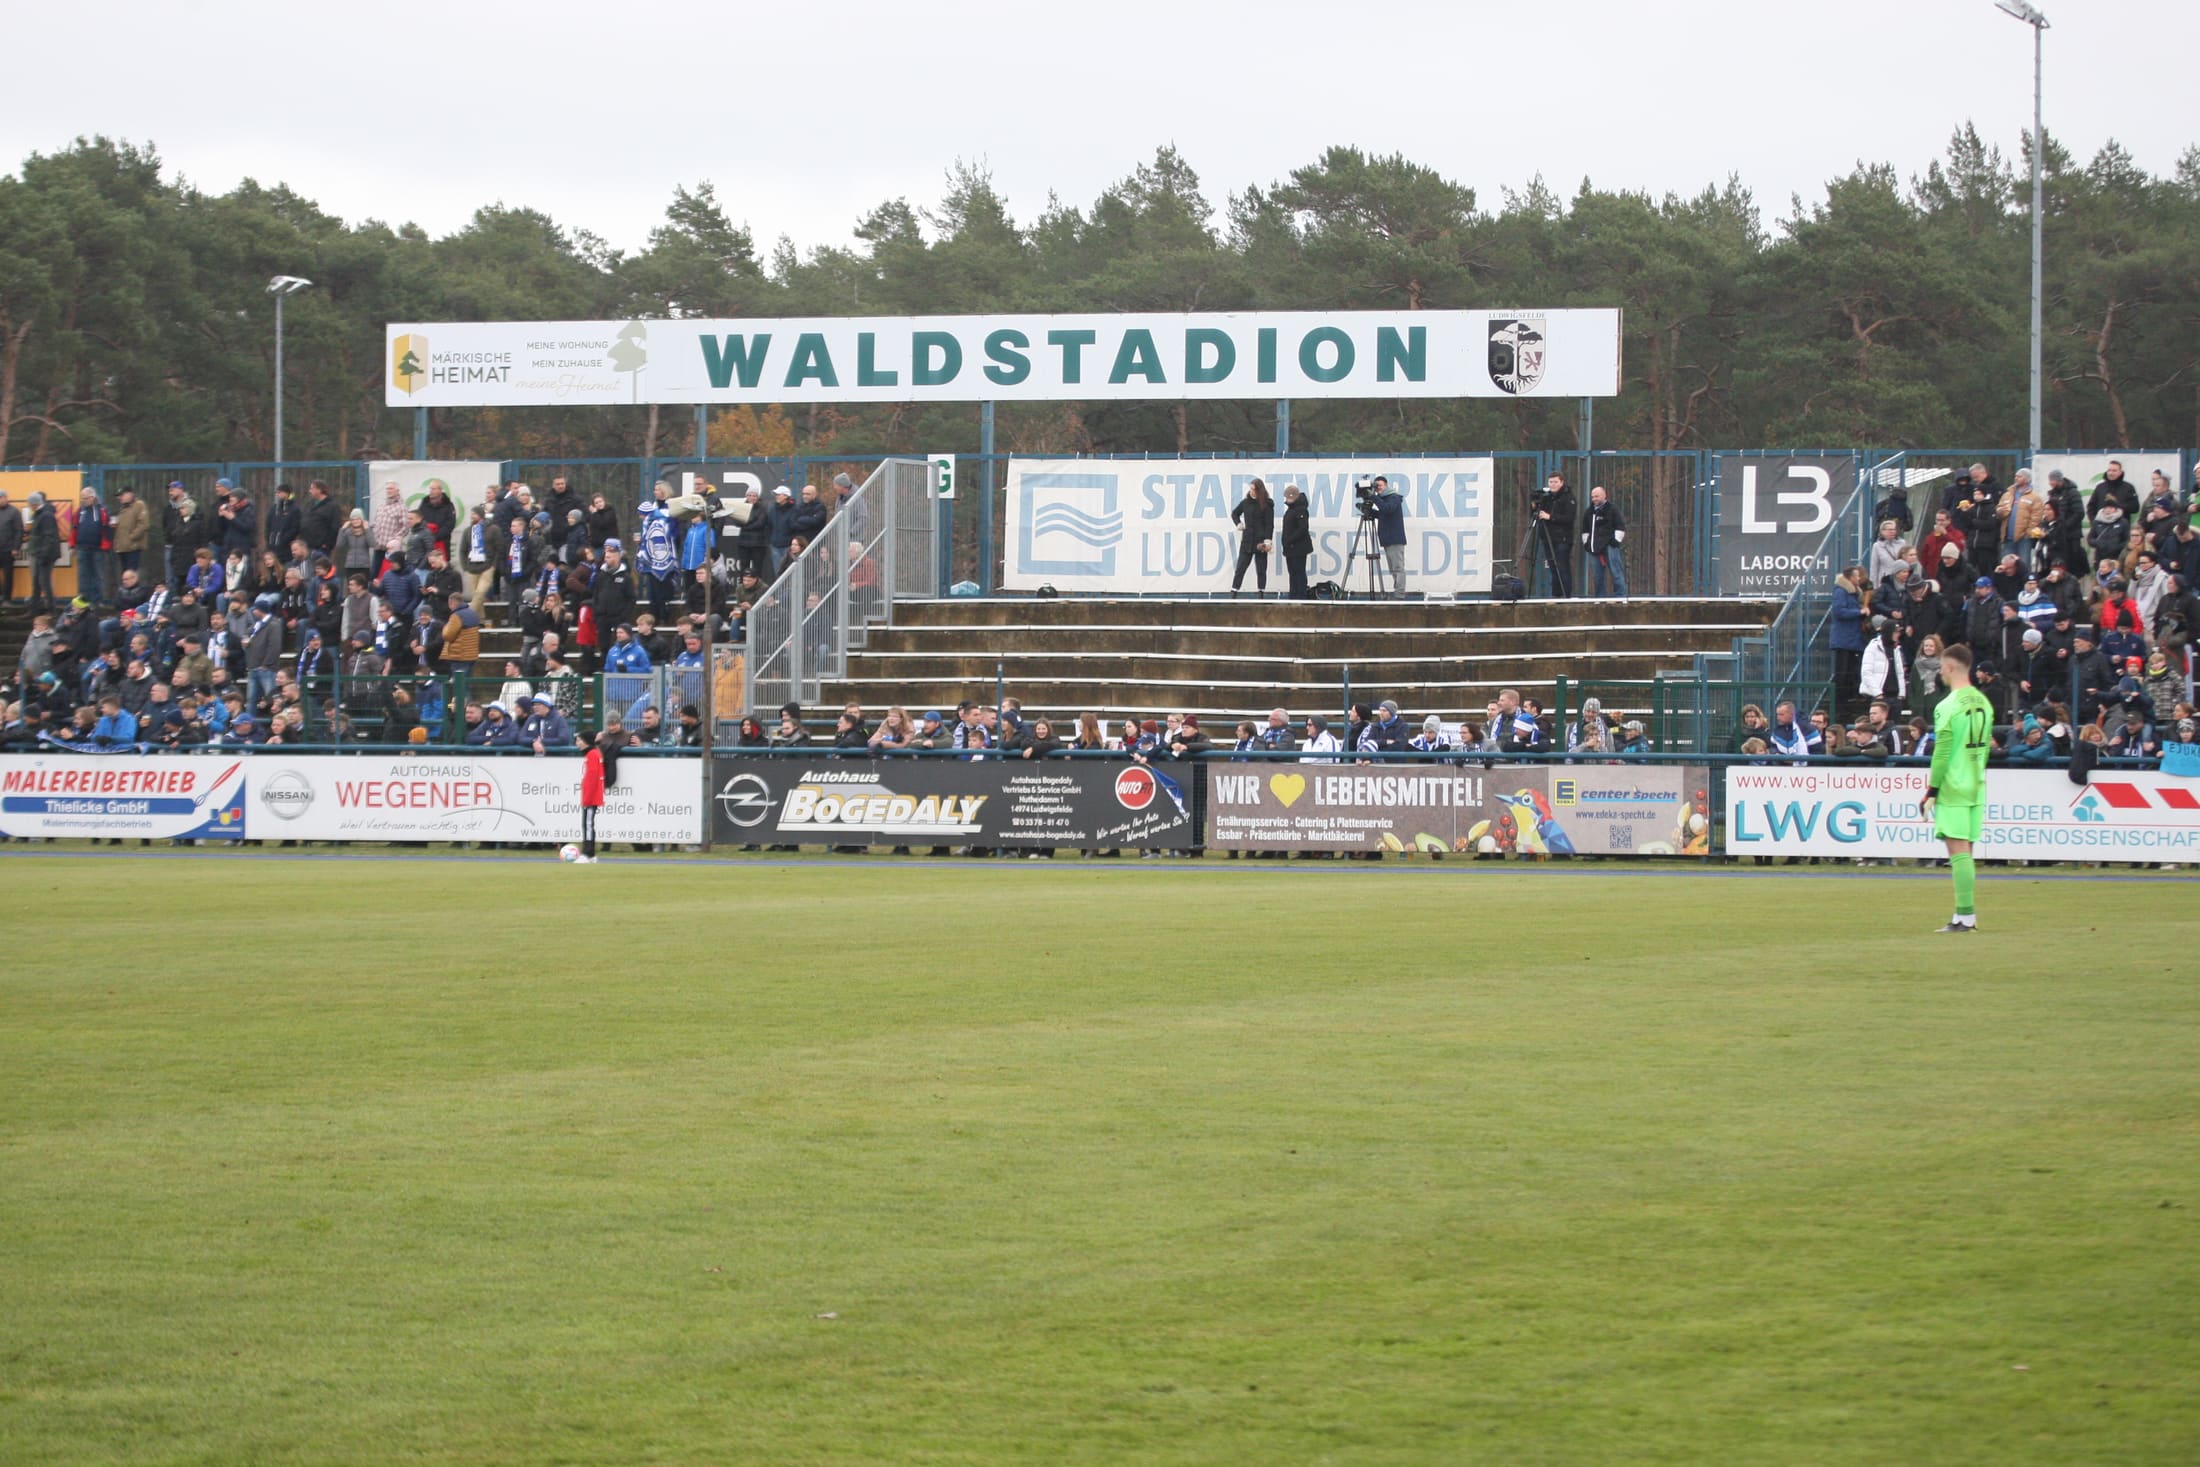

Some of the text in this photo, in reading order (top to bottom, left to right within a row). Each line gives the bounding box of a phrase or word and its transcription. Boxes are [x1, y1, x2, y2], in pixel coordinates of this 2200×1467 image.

[559, 341, 608, 350] WOHNUNG
[432, 352, 511, 364] MÄRKISCHE
[532, 359, 602, 368] MEIN ZUHAUSE
[700, 327, 1427, 389] WALDSTADION
[432, 366, 511, 384] HEIMAT
[1142, 531, 1479, 577] LUDISFDE
[1965, 707, 1986, 748] 12
[390, 766, 471, 777] AUTOHAUS
[800, 770, 880, 783] Autohaus
[2, 770, 196, 793] MALEREIBETRIEB
[1011, 776, 1073, 785] Autohaus Bogedaly
[1736, 773, 1929, 793] www.wg-ludwigsfel
[264, 791, 309, 800] NISSAN
[336, 781, 492, 808] WEGENER
[521, 783, 632, 796] Berlin Pdam
[1002, 786, 1030, 794] Vertriebs
[1037, 786, 1060, 794] Service
[1061, 786, 1082, 794] GmbH
[1215, 776, 1483, 807] WIR LEBENSMITTEL!
[1581, 788, 1678, 801] center Specht
[45, 800, 148, 814] Thielicke GmbH
[545, 802, 692, 815] Ludwsfelde Nauen
[783, 786, 987, 824] BOGEDALY
[1011, 805, 1073, 814] 14974 Ludwigsfelde
[1576, 810, 1656, 820] www.edeka-specht.de
[1735, 800, 1868, 842] LWG
[366, 819, 415, 830] Vertrauen
[1216, 816, 1394, 829] Ernährungsservice Catering & Plattenservice
[521, 828, 691, 840] www.autous-wegener.de
[999, 830, 1086, 840] www.autohaus-bogedaly.de
[1216, 829, 1365, 842] Essbar Präsentkörbe Marktbäckerei
